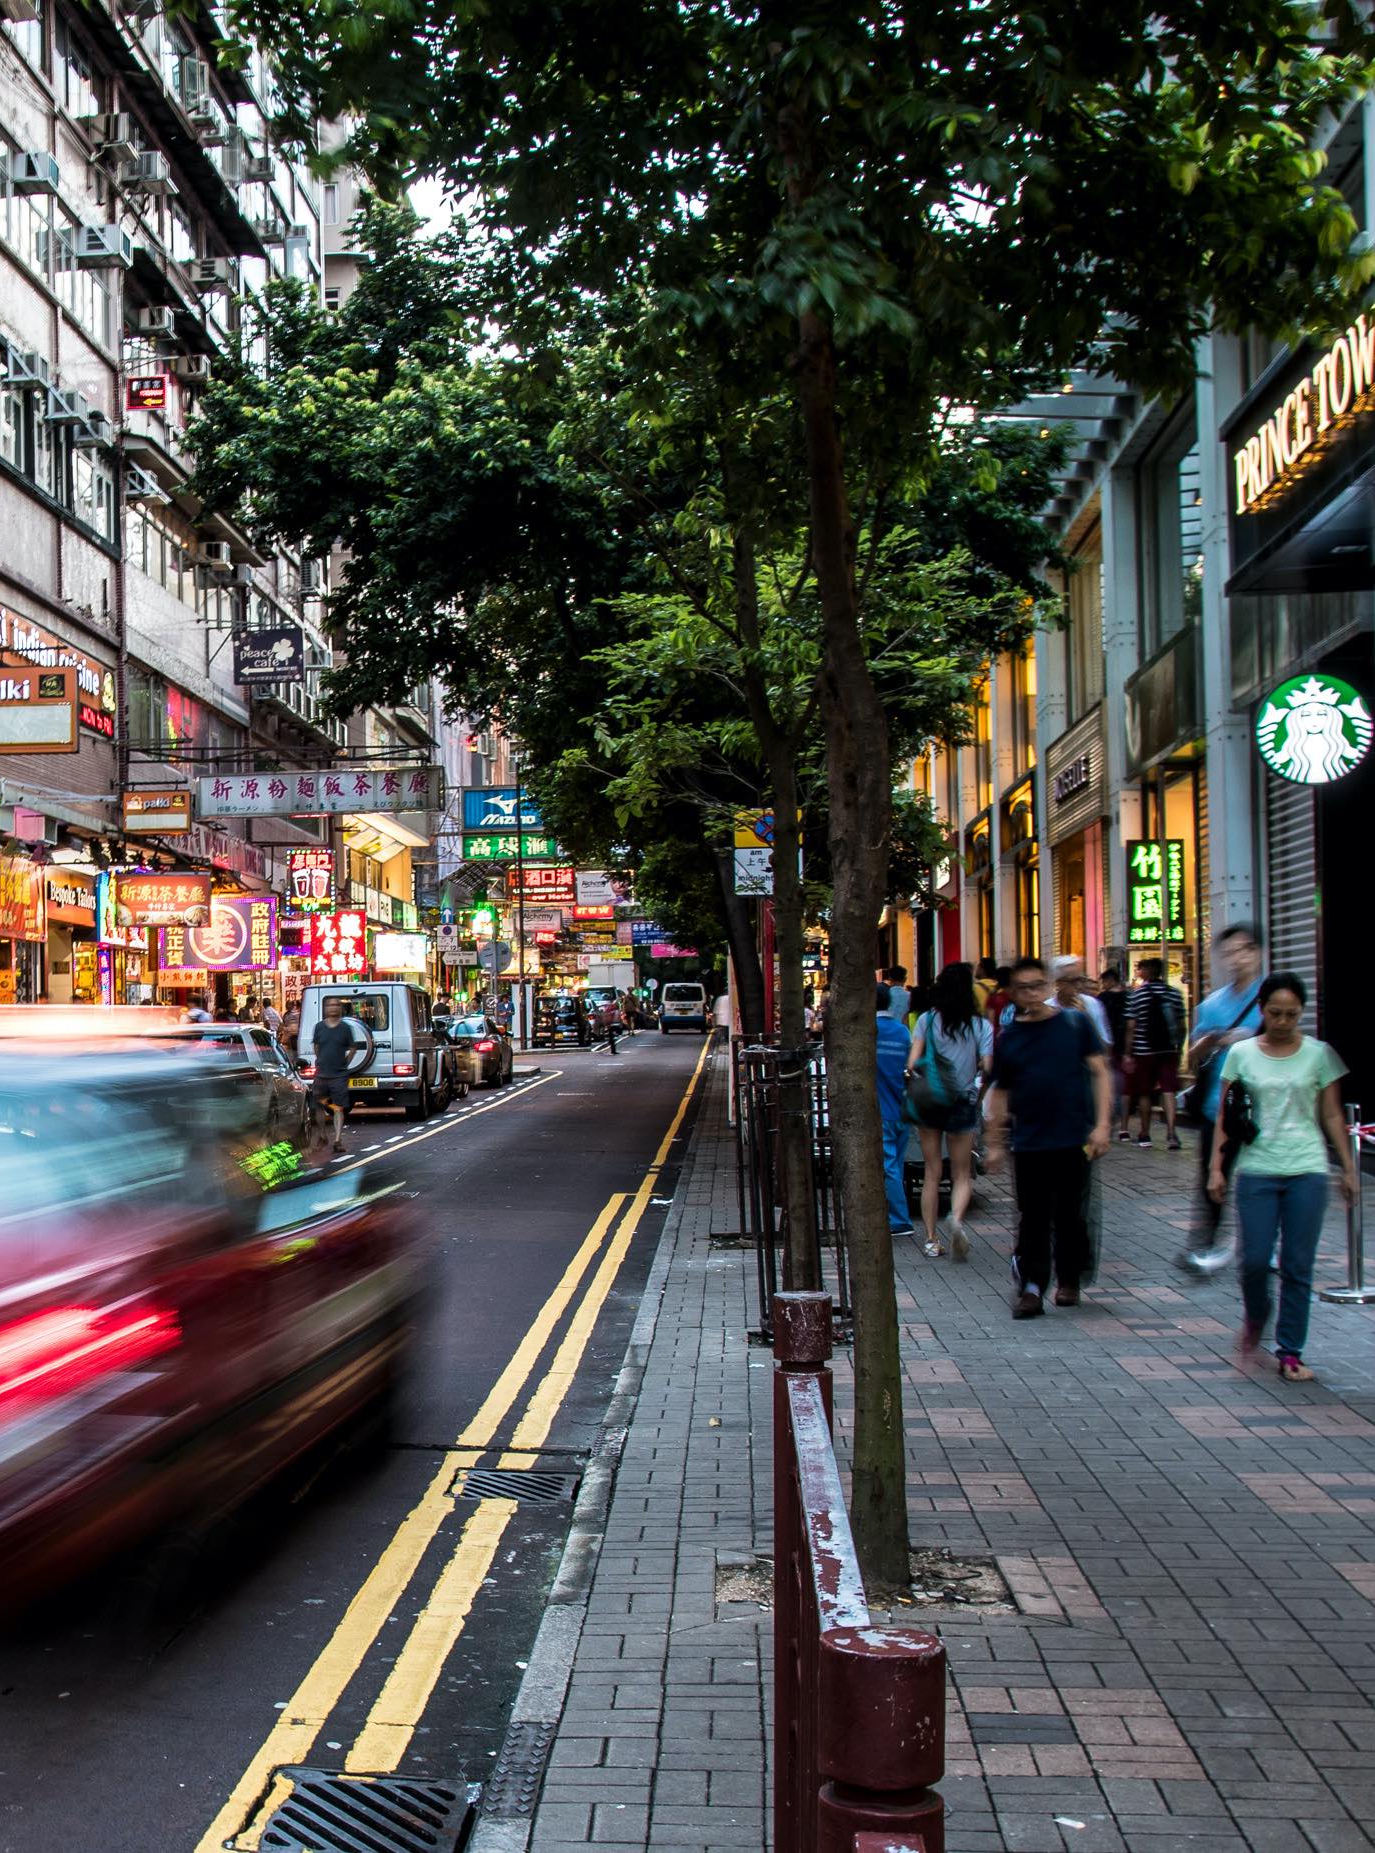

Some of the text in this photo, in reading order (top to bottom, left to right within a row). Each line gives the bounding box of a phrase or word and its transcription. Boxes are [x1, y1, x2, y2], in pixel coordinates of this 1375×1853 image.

[1234, 377, 1313, 514] PRINCE
[240, 649, 274, 661] peace
[210, 770, 430, 801] 新源粉麵飯茶餐廳
[49, 879, 97, 911] Bespoke Tailors
[251, 902, 270, 965] 政府註冊
